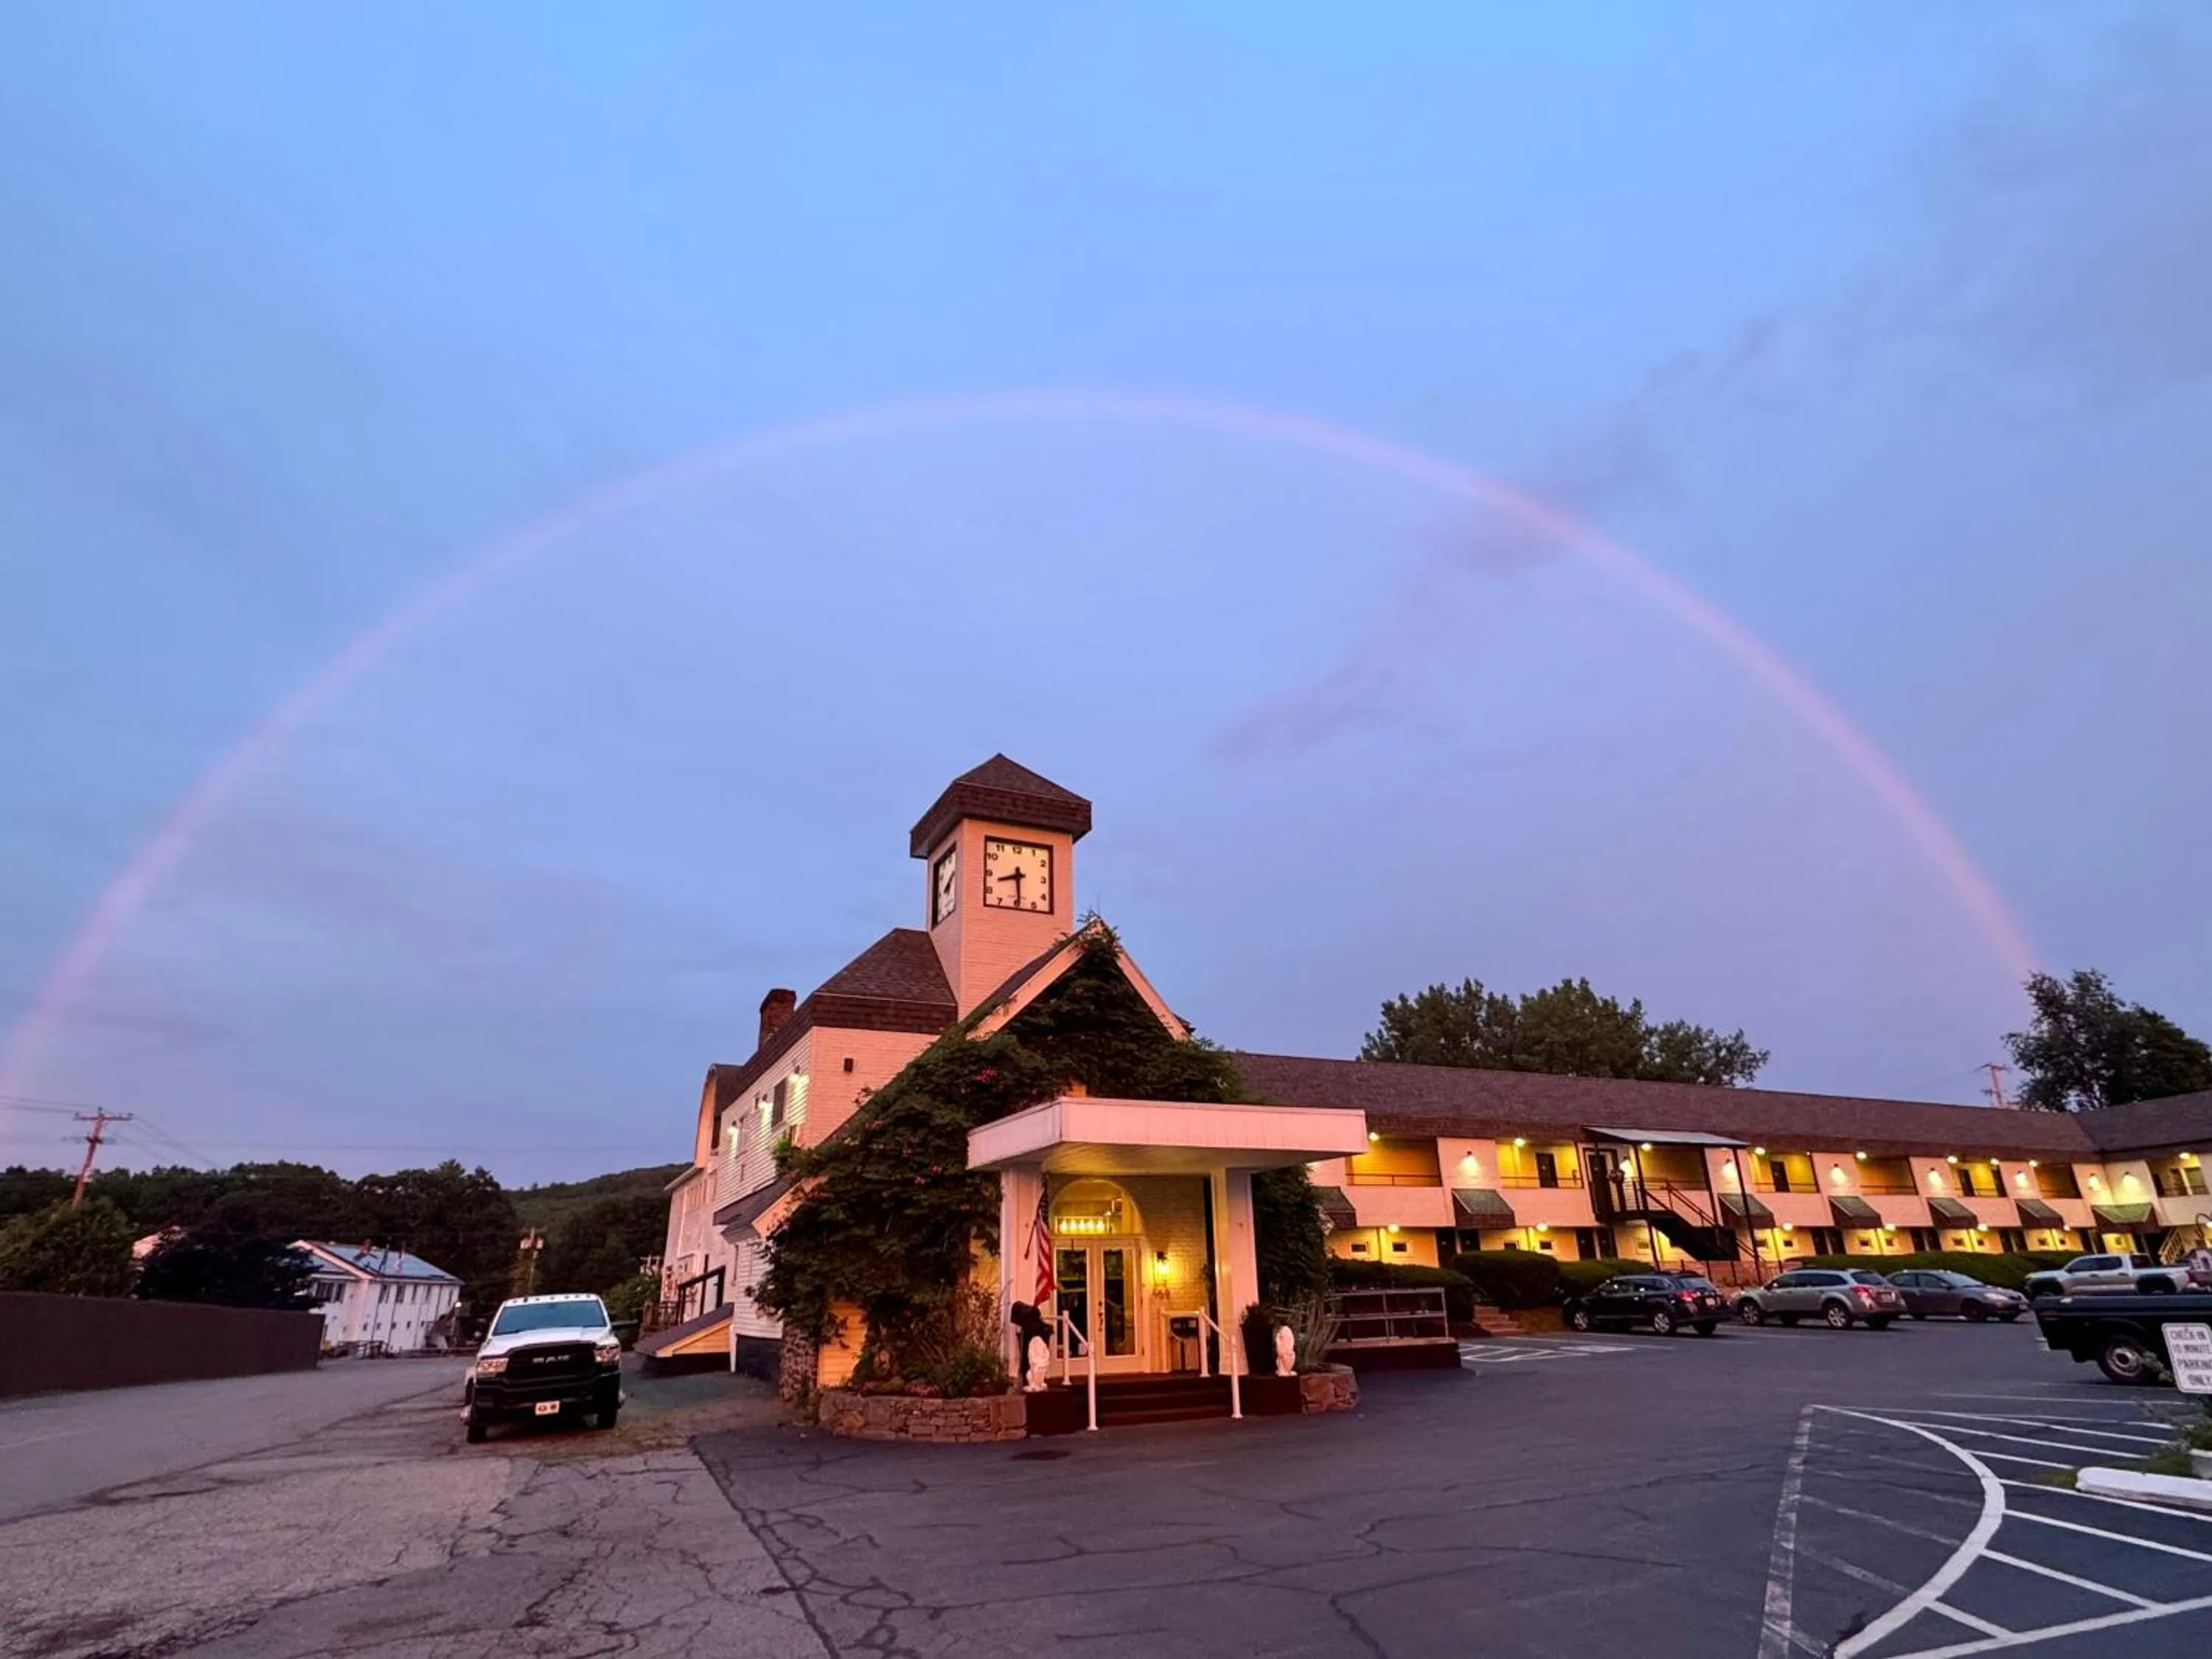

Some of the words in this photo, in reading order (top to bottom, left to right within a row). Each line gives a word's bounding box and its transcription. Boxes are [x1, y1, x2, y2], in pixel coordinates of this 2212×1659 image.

[996, 844, 1005, 852] 11
[1012, 846, 1022, 855] 12
[987, 852, 998, 861] 10
[1032, 849, 1036, 857] 1
[1039, 859, 1046, 868] 2
[1040, 876, 1046, 885] 3
[996, 897, 1003, 906] 7
[1040, 893, 1047, 902] 4
[1031, 902, 1037, 910] 5
[2170, 1330, 2196, 1340] CHECK
[2197, 1331, 2207, 1340] IN
[532, 1354, 570, 1364] RAM
